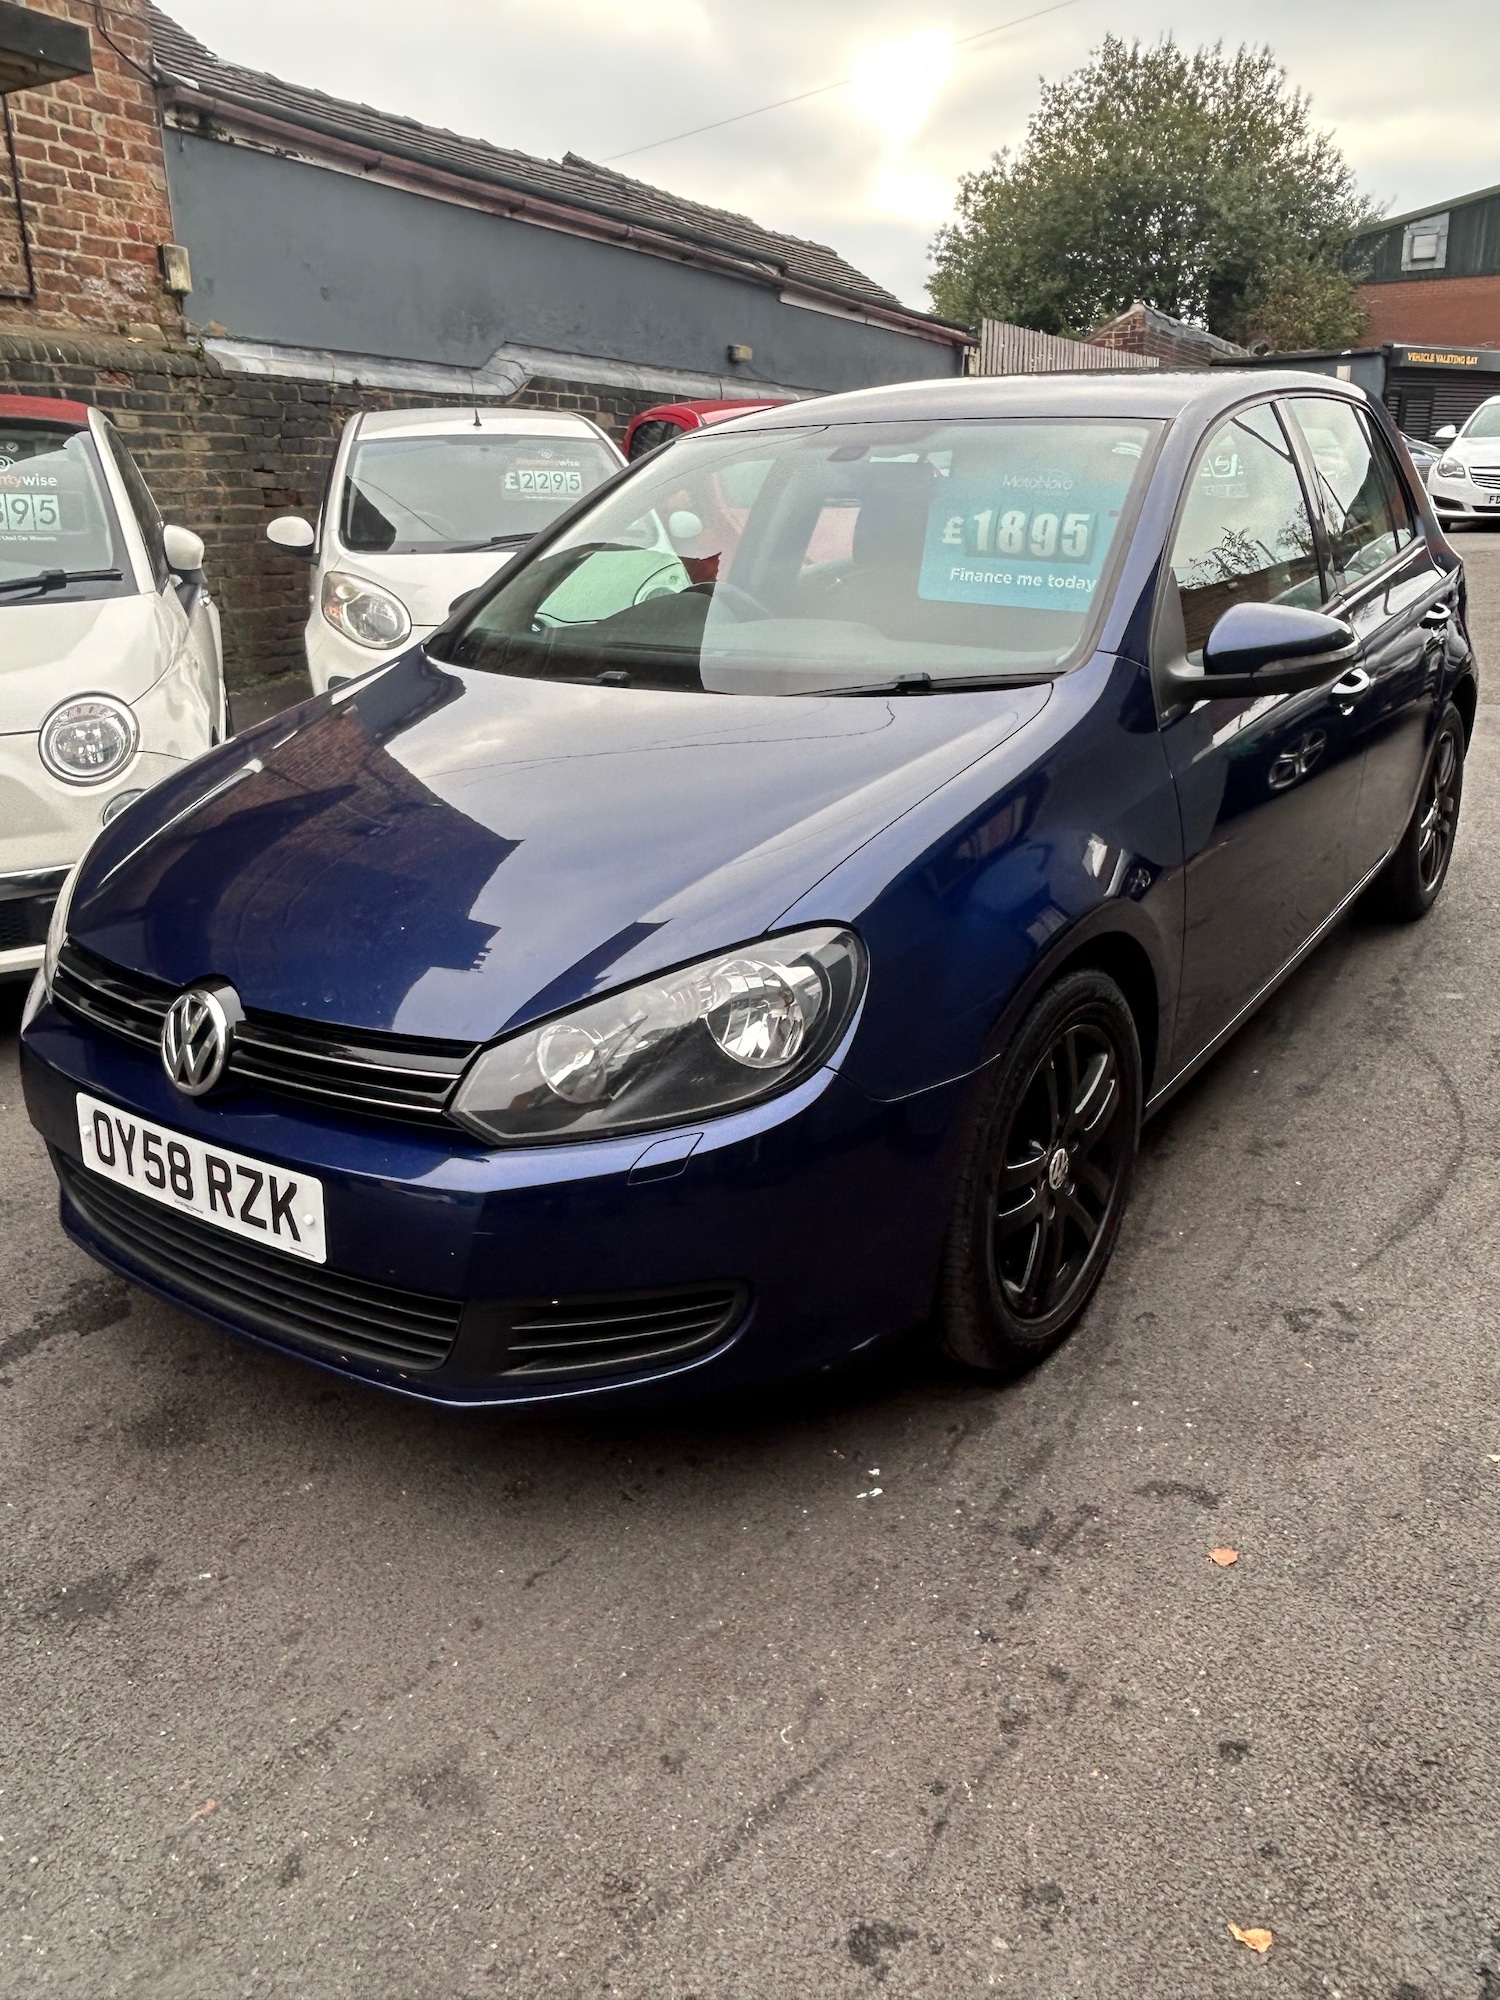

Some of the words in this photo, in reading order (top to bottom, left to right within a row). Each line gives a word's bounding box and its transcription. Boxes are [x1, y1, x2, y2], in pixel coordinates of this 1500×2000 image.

[1407, 352, 1435, 363] VEHICLE
[504, 471, 580, 491] £2295
[0, 497, 57, 526] 95
[942, 509, 1091, 558] £1895
[950, 567, 1013, 585] Finance
[1016, 574, 1043, 587] me
[1048, 574, 1098, 593] today
[93, 1109, 194, 1201] OY58
[205, 1153, 301, 1242] RZK
